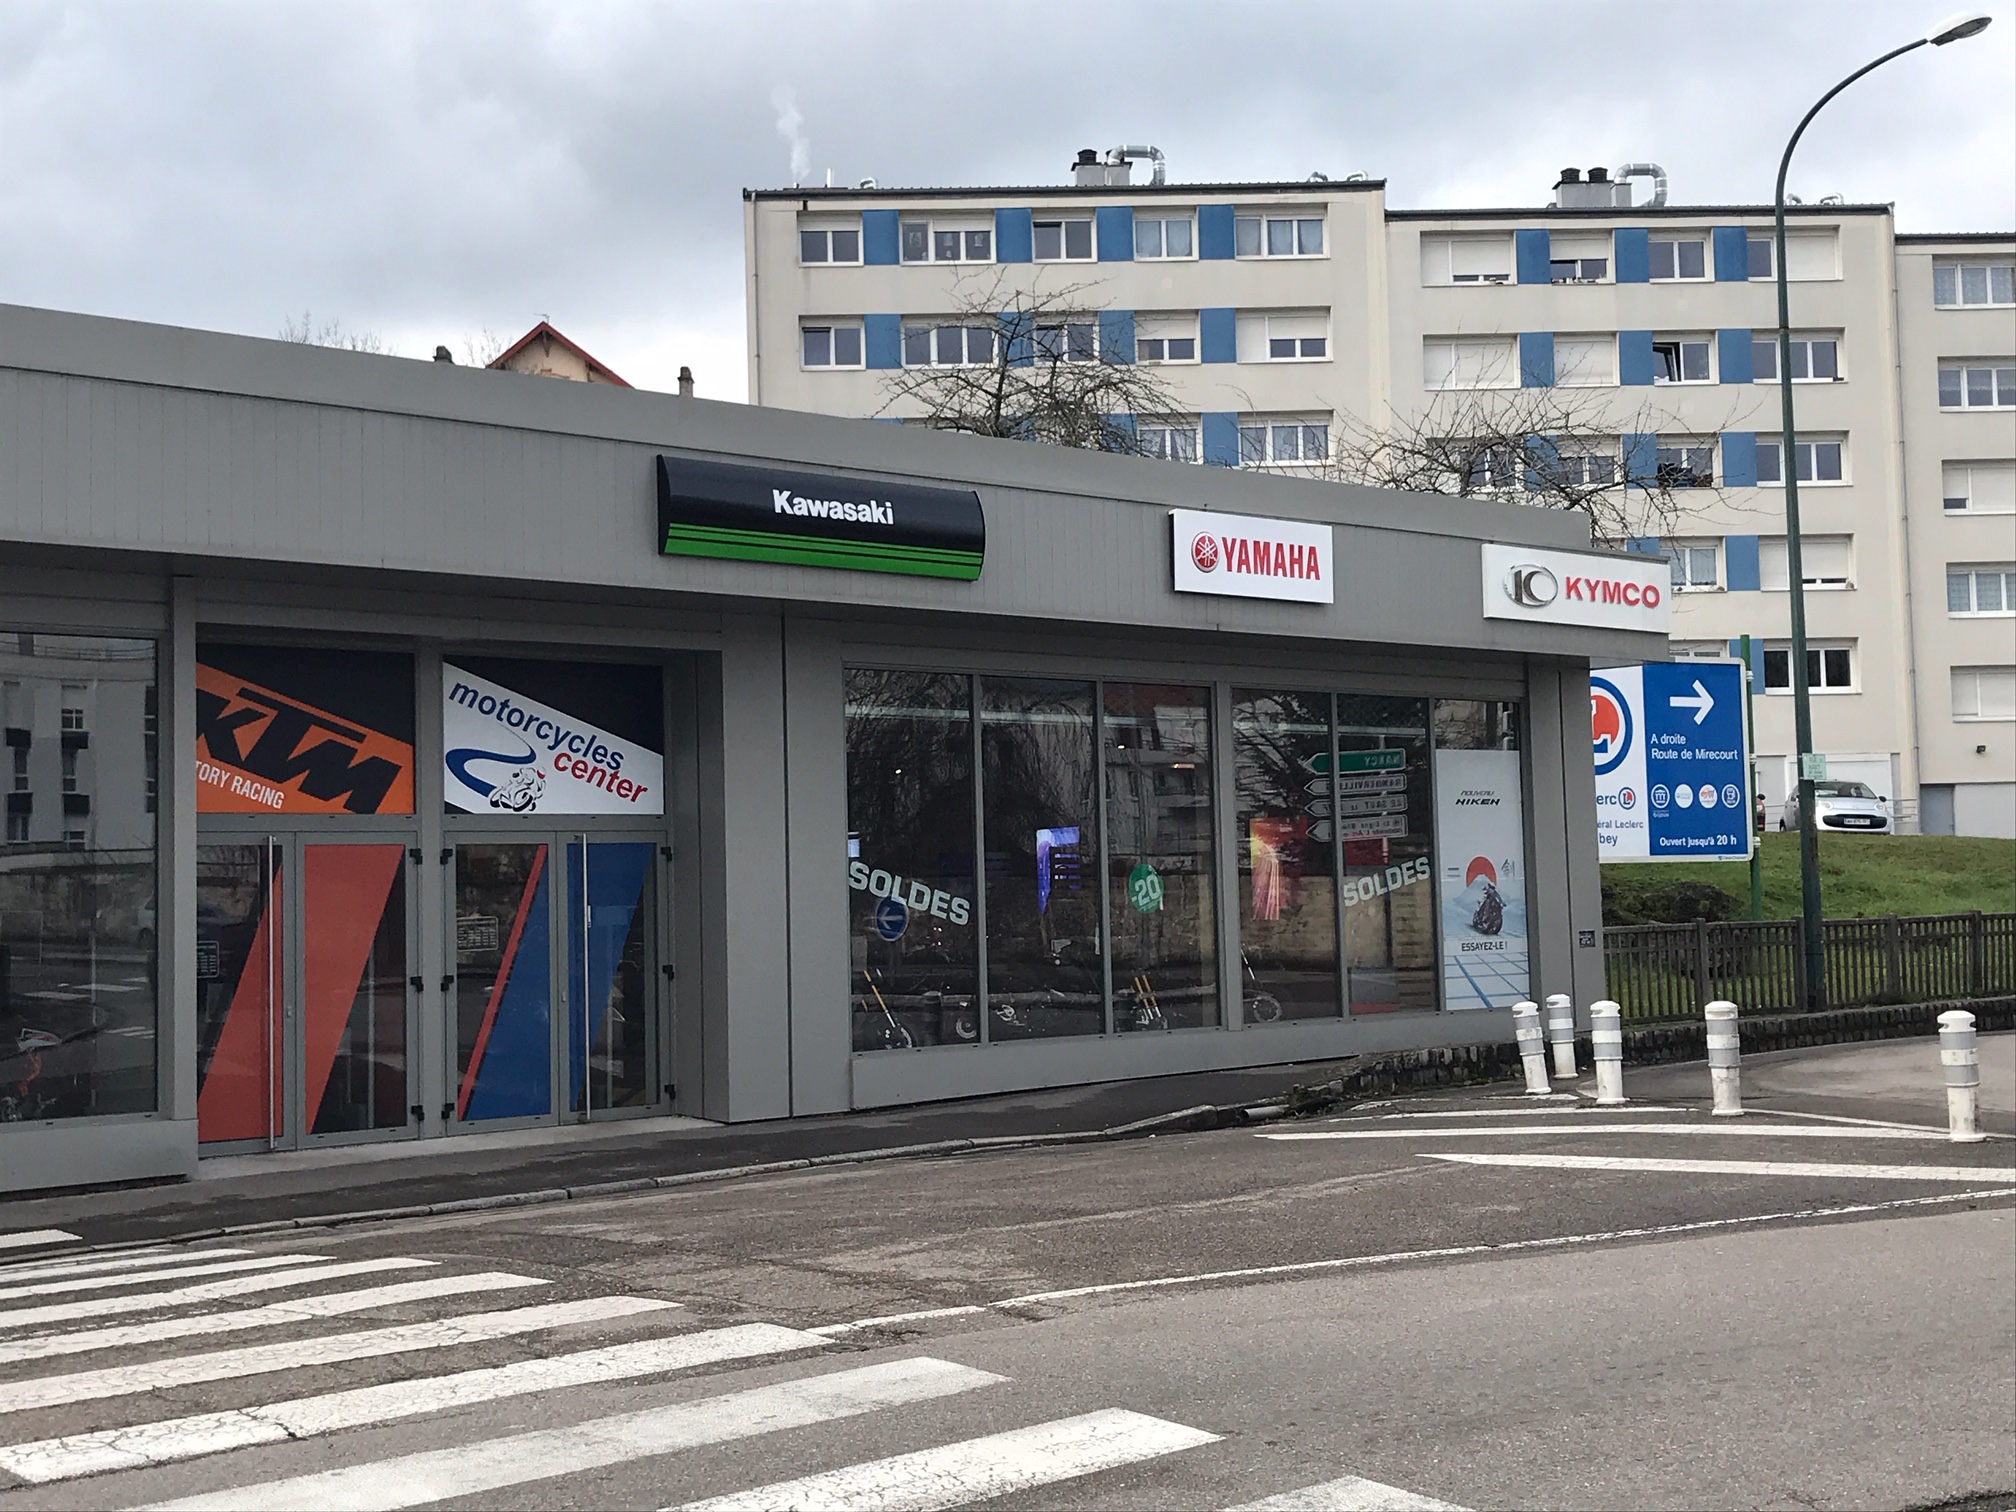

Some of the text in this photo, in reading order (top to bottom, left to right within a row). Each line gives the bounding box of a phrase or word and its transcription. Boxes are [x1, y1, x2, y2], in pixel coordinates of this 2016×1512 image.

[772, 489, 894, 525] Kawasaki
[1221, 536, 1321, 581] YAMAHA
[1565, 576, 1661, 609] KYMCO
[449, 682, 624, 771] motorcycles
[1650, 733, 1686, 744] A droite
[196, 686, 403, 815] KTM
[1651, 748, 1738, 760] Route de Mirecourt
[231, 774, 285, 810] RACING
[554, 752, 648, 802] center
[1455, 798, 1500, 806] NIKEN
[1597, 820, 1644, 829] éral Leclerc
[1660, 835, 1737, 847] Ouvert jusqu'à 20 h
[849, 861, 970, 926] SOLDES
[1343, 856, 1431, 907] SOLDES
[1461, 941, 1503, 951] ESSAYEZ-LE
